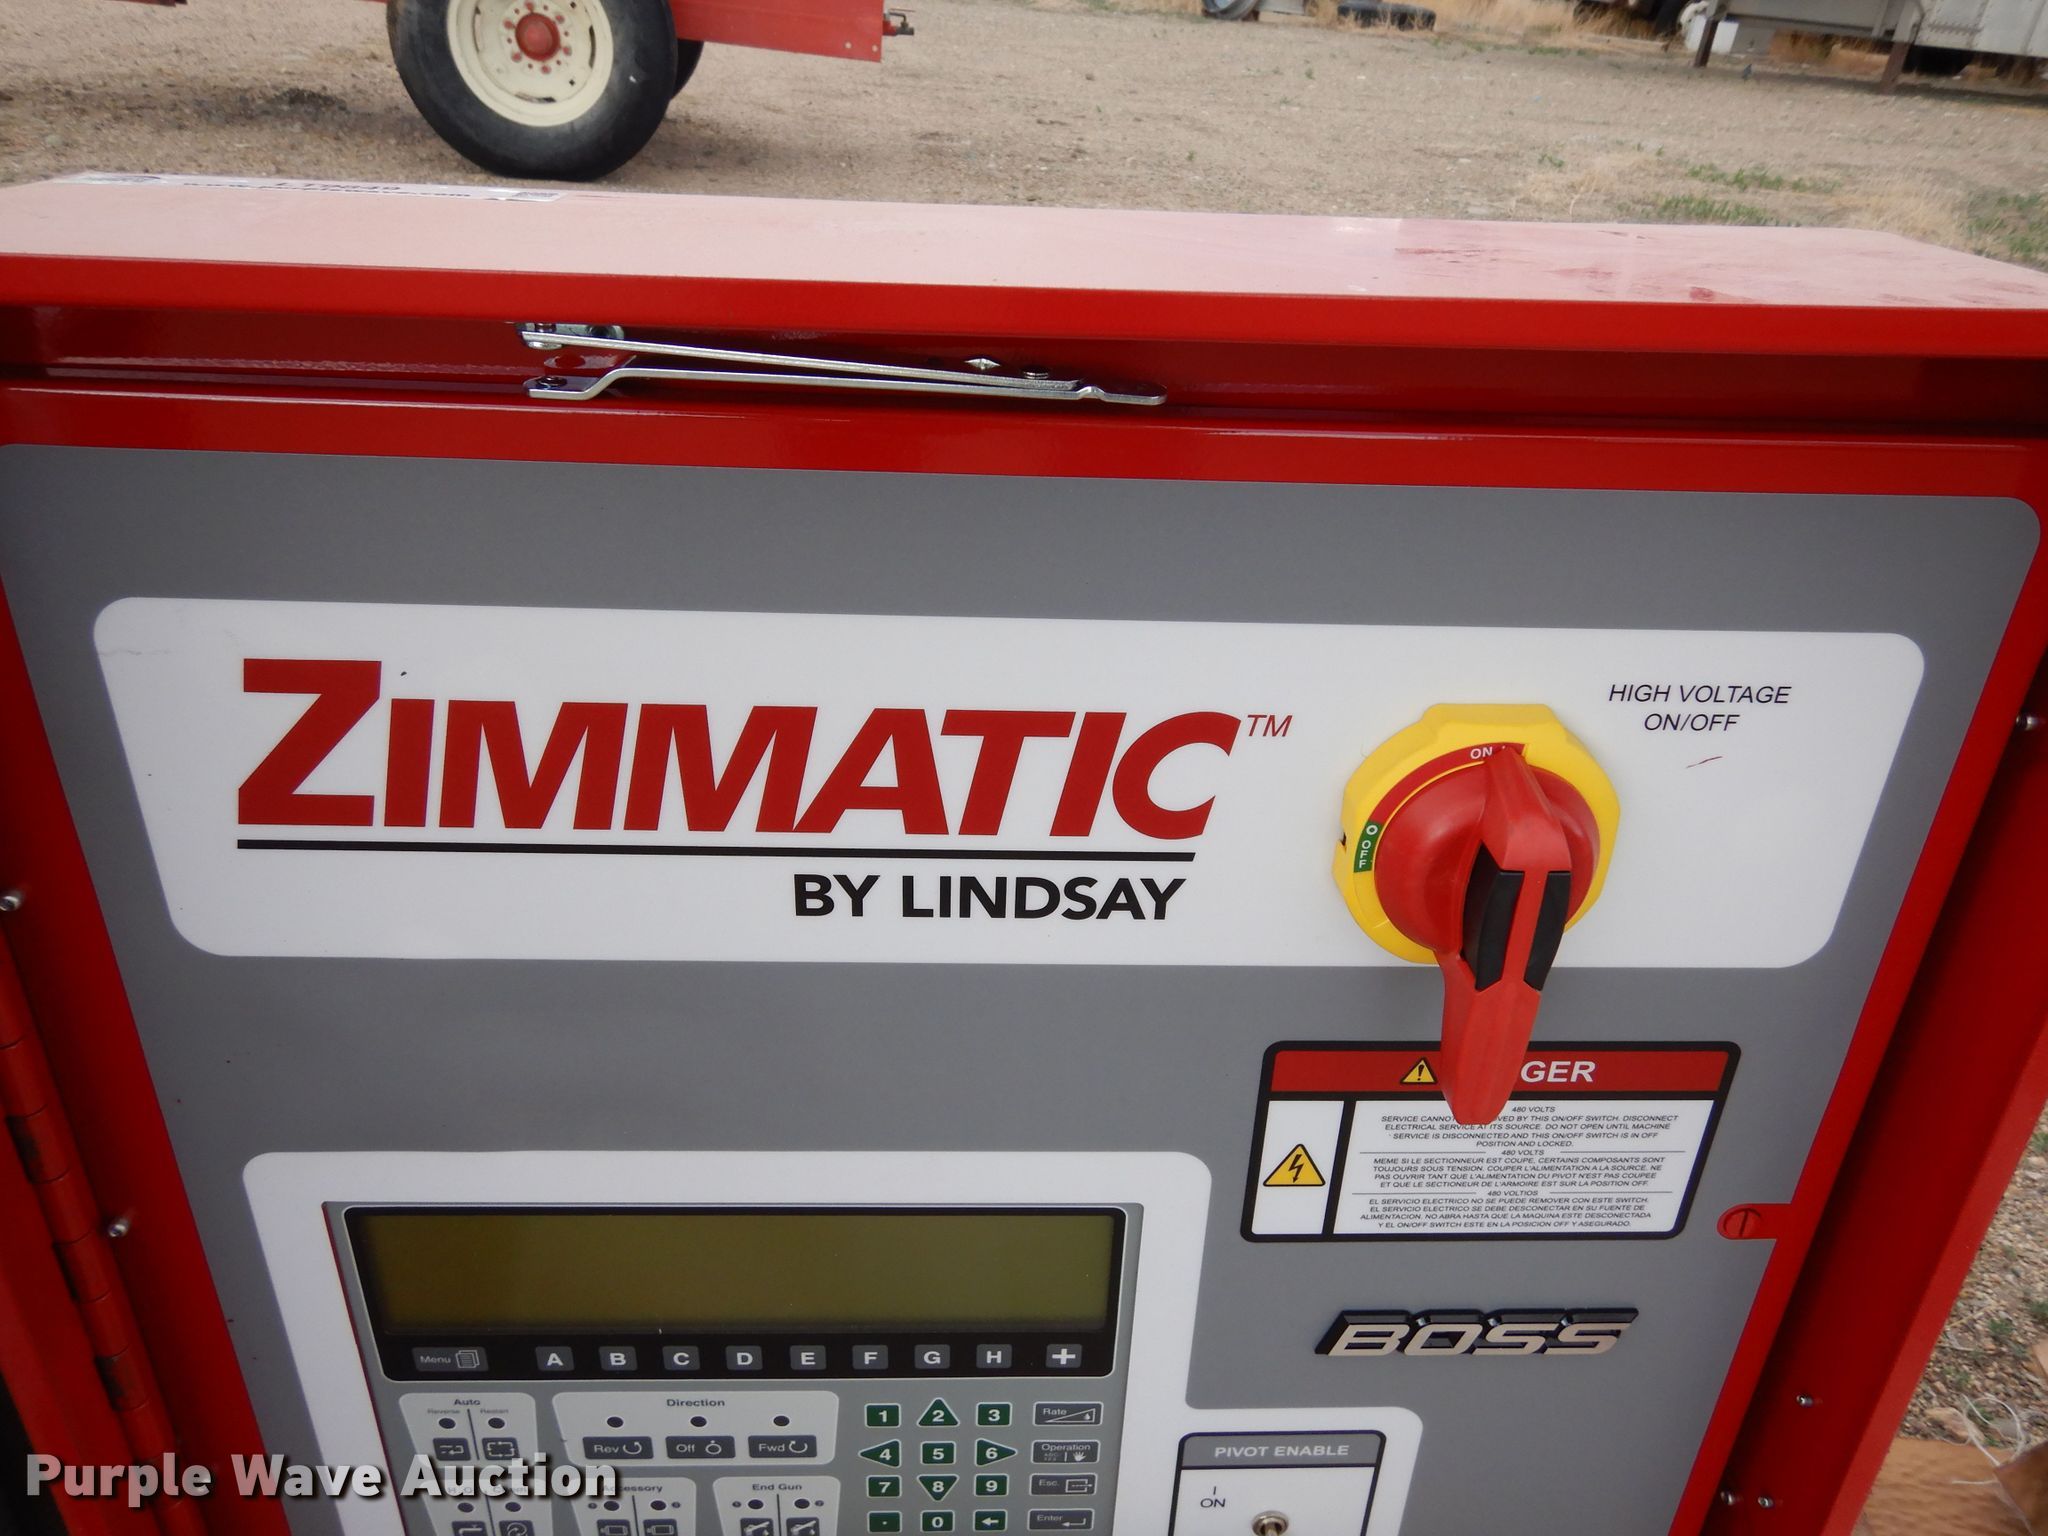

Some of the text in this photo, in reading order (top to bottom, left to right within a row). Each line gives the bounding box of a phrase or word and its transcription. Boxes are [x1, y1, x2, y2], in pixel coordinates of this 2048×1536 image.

[1609, 684, 1791, 704] HIGH VOLTAGE
[1247, 716, 1292, 736] TM
[1644, 714, 1740, 732] ON/OFF
[238, 658, 1241, 840] ZIMMATIC
[1470, 747, 1492, 759] ON
[1359, 840, 1371, 868] OFF
[794, 875, 1186, 921] BY LINDSAY
[1521, 1061, 1595, 1083] GER
[1325, 1316, 1635, 1356] BOSS
[420, 1355, 451, 1364] Menu
[547, 1352, 563, 1365] A
[610, 1352, 626, 1365] B
[673, 1352, 689, 1365] C
[736, 1352, 753, 1365] D
[801, 1352, 814, 1365] E
[864, 1351, 878, 1365] F
[924, 1351, 941, 1365] G
[986, 1351, 1002, 1365] H
[666, 1398, 725, 1407] Direction
[879, 1410, 887, 1422] 1
[932, 1410, 944, 1421] 2
[989, 1409, 1000, 1421] 3
[593, 1443, 619, 1454] Rev
[676, 1443, 695, 1453] Off
[758, 1442, 785, 1453] Fwd
[933, 1448, 944, 1459] 5
[986, 1448, 998, 1459] 6
[1215, 1445, 1349, 1458] PIVOT ENABLE
[880, 1449, 891, 1460] 4
[879, 1482, 891, 1493] 7
[932, 1481, 944, 1492] 8
[986, 1480, 998, 1492] 9
[1200, 1498, 1225, 1507] ON
